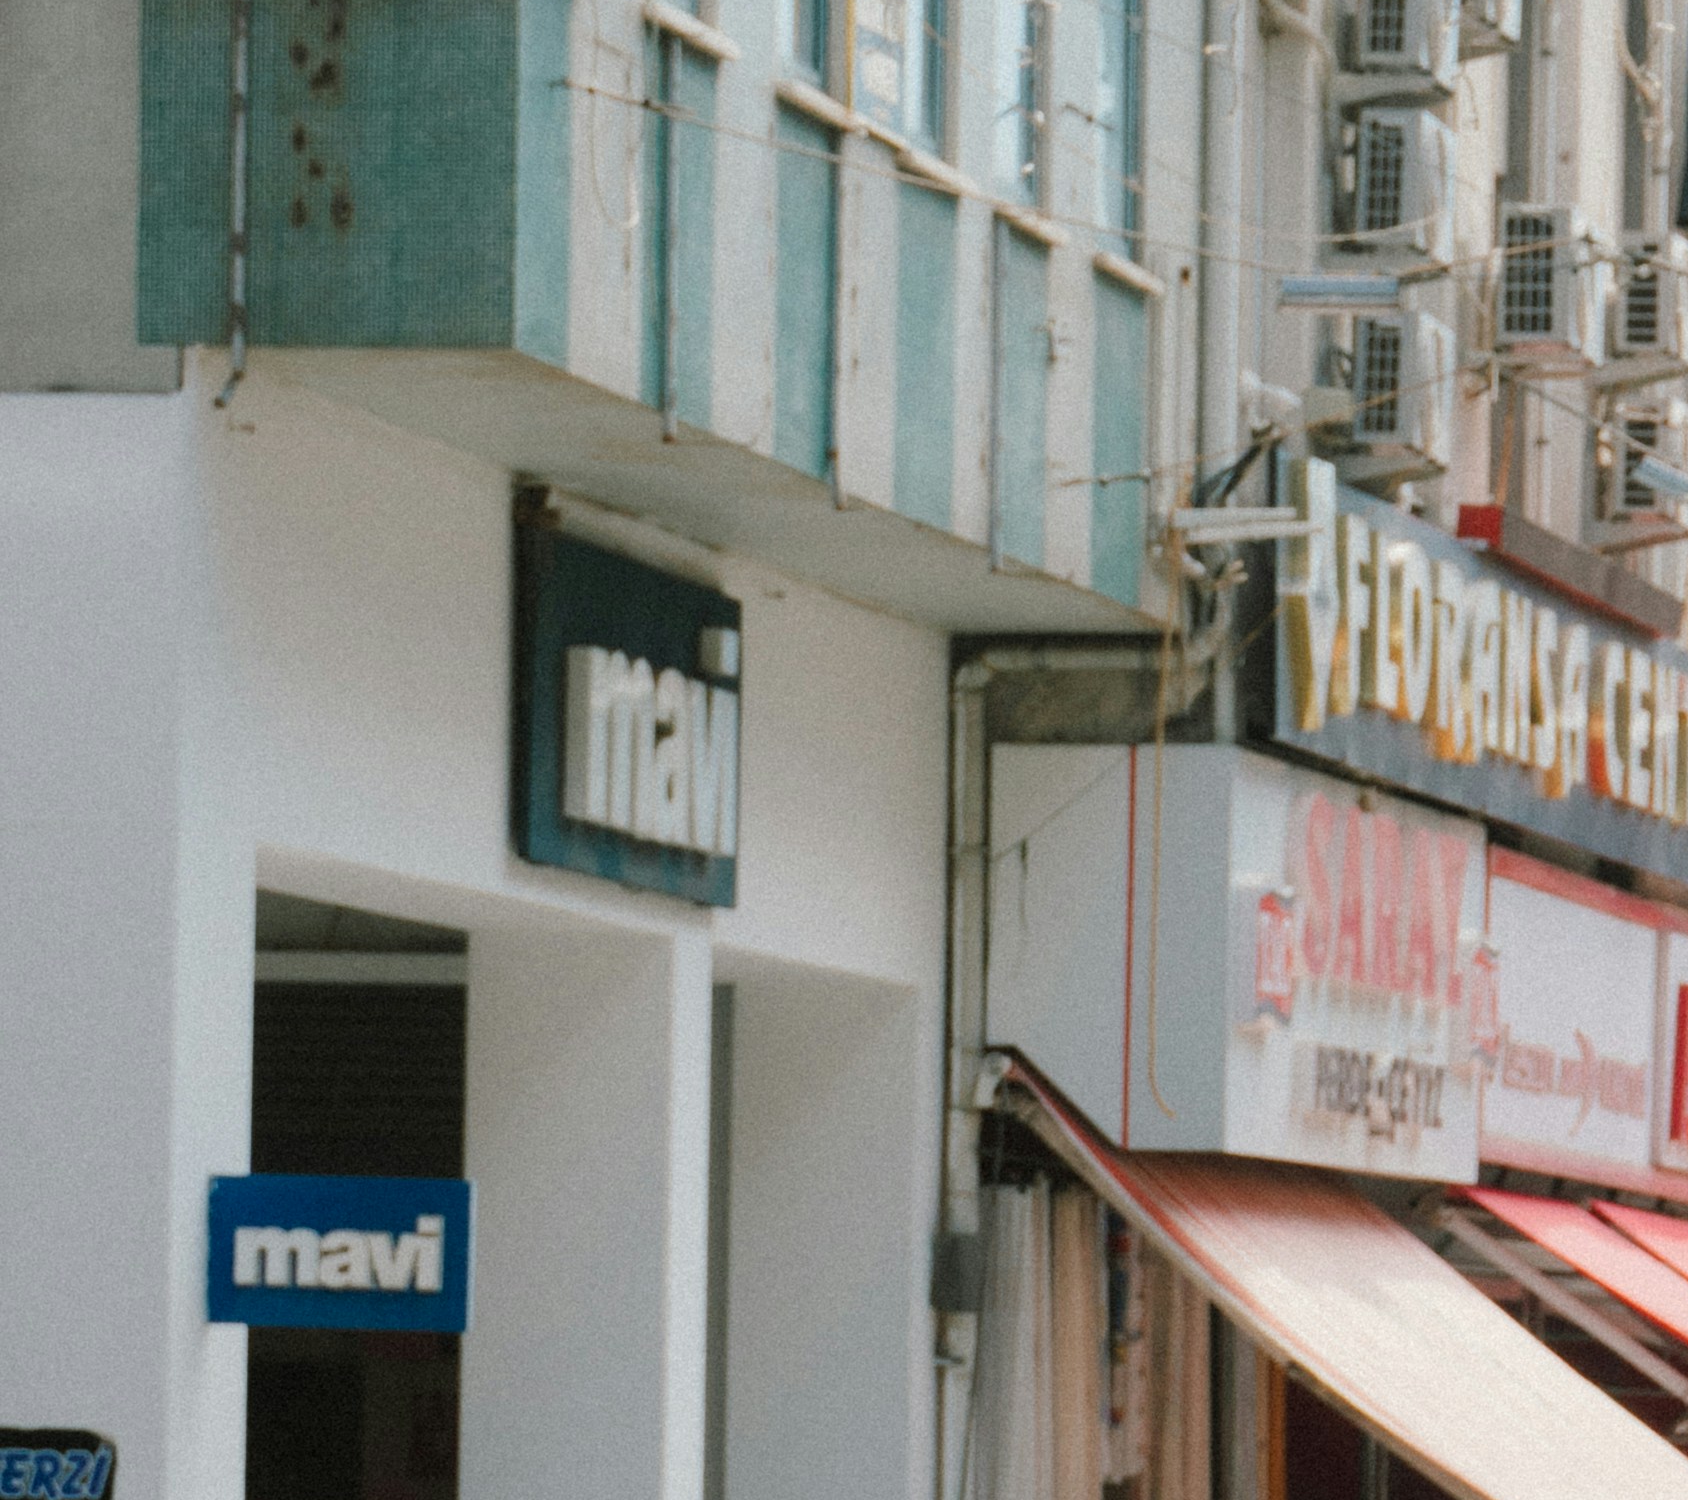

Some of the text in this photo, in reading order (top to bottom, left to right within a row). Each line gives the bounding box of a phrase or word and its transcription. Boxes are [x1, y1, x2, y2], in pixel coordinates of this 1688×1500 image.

[564, 627, 739, 857] mavi
[1303, 791, 1468, 1007] SARAY
[233, 1215, 445, 1292] mavi
